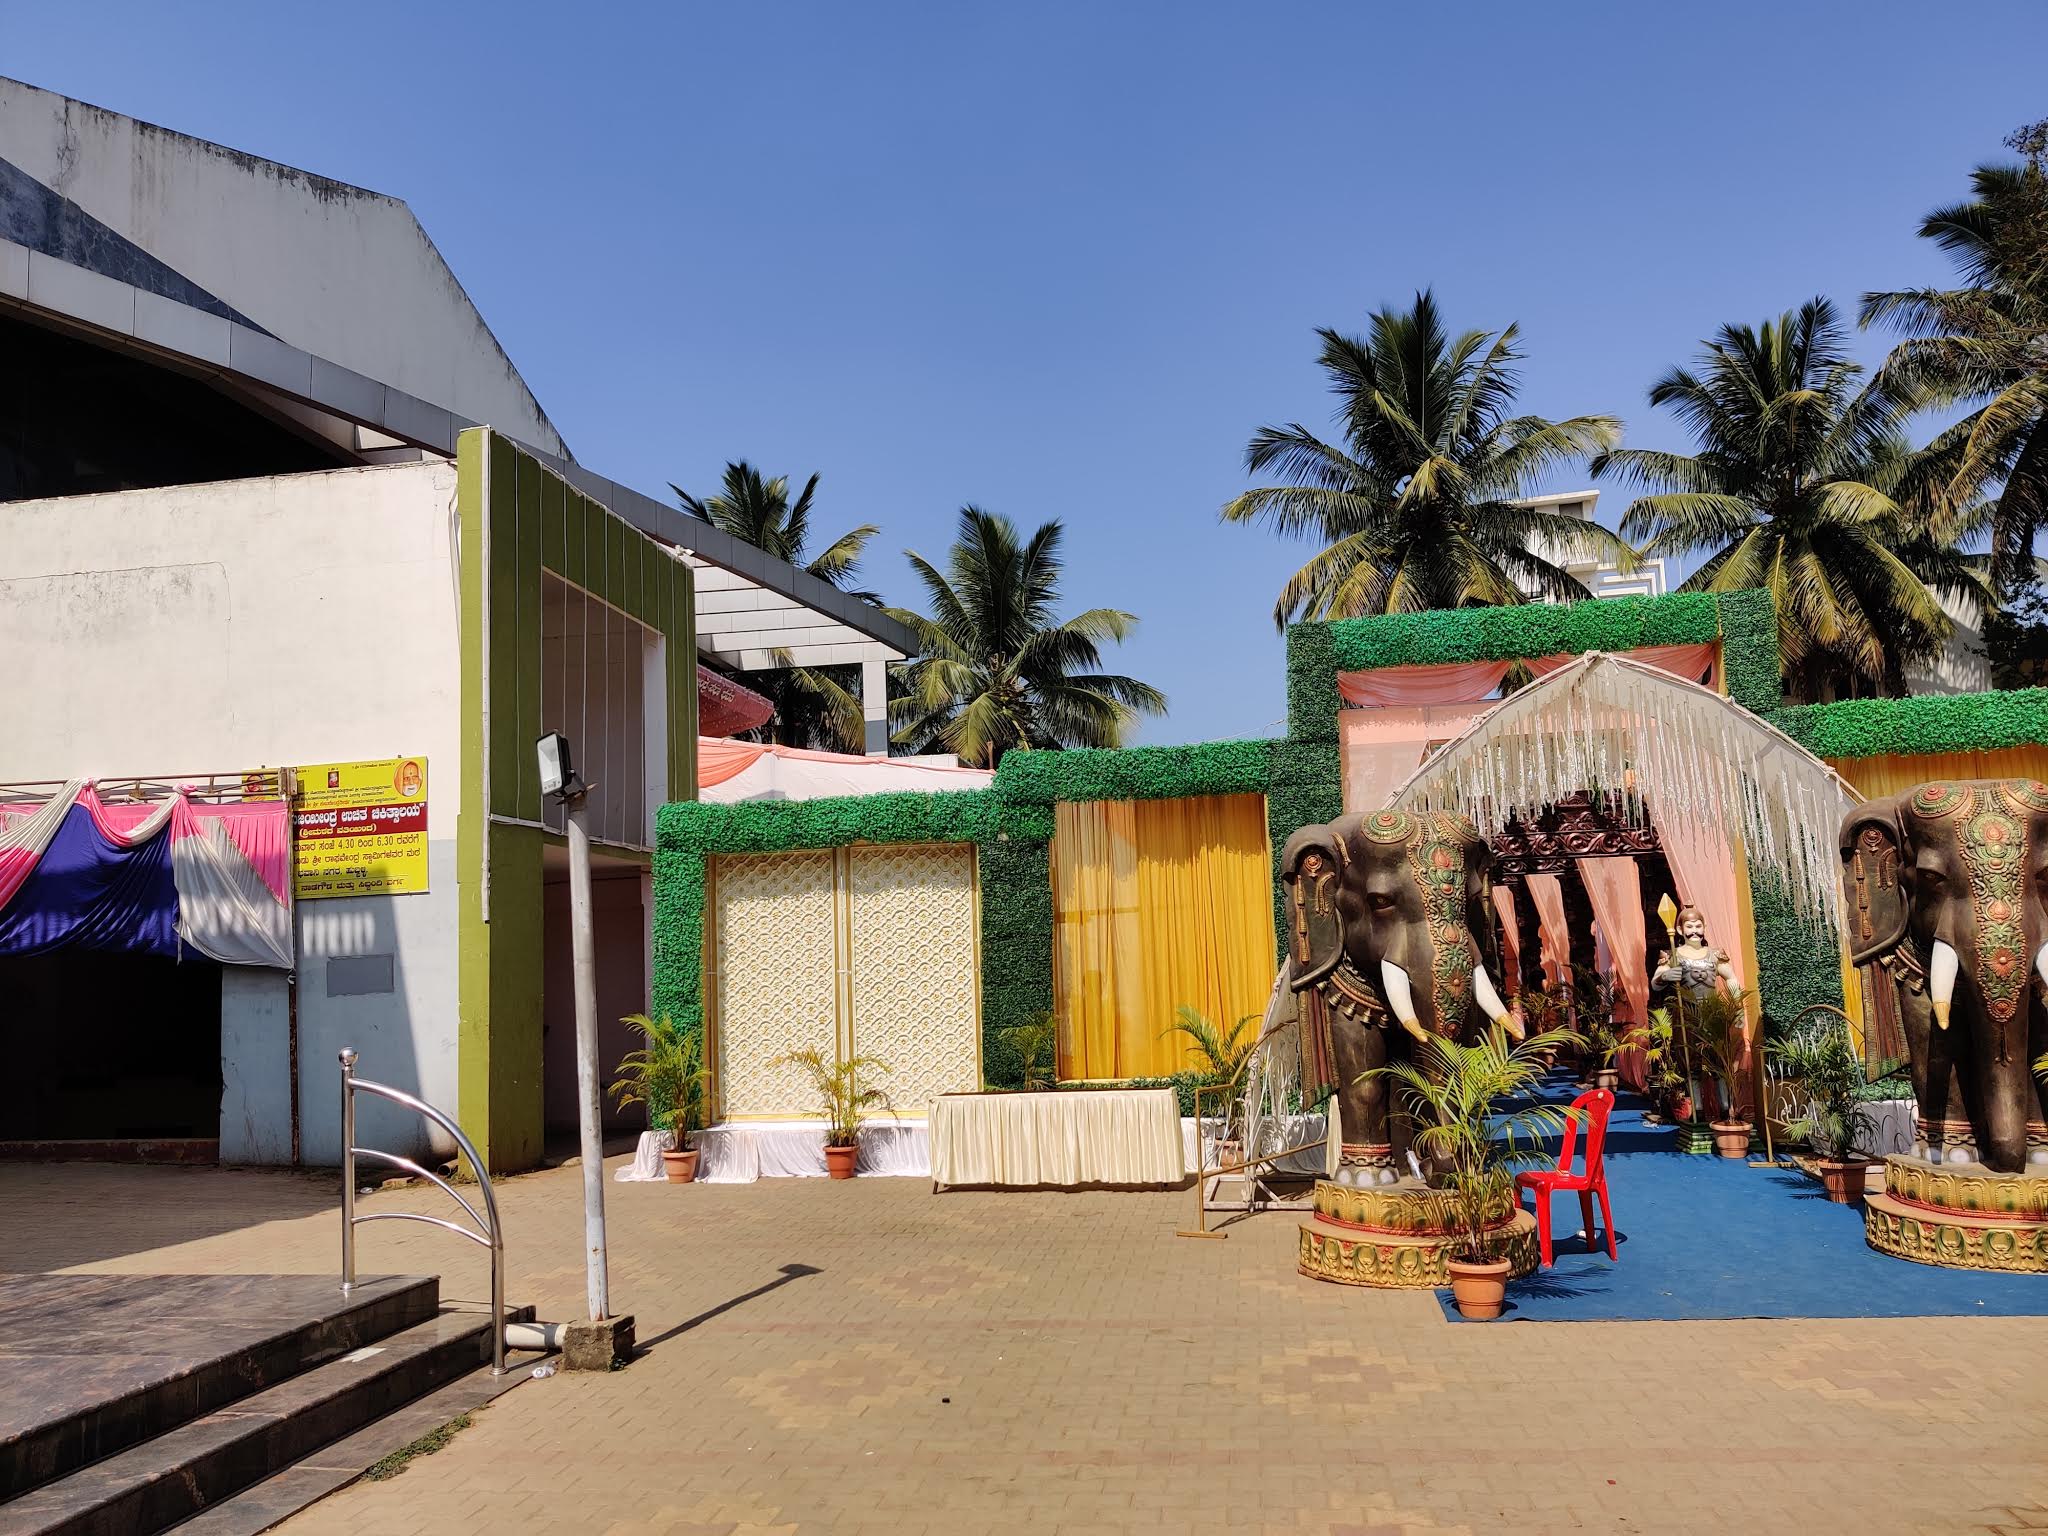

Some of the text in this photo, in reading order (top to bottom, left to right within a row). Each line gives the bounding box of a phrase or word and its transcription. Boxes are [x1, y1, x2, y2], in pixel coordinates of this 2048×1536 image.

[341, 808, 368, 821] ಉಚಿತ
[319, 840, 335, 851] ಸಂಜೆ
[338, 838, 355, 849] 4.30
[358, 837, 374, 848] ರಿಂದ
[377, 836, 394, 847] 6.30
[324, 852, 360, 864] ರಾಘವೇಂದ್ರ
